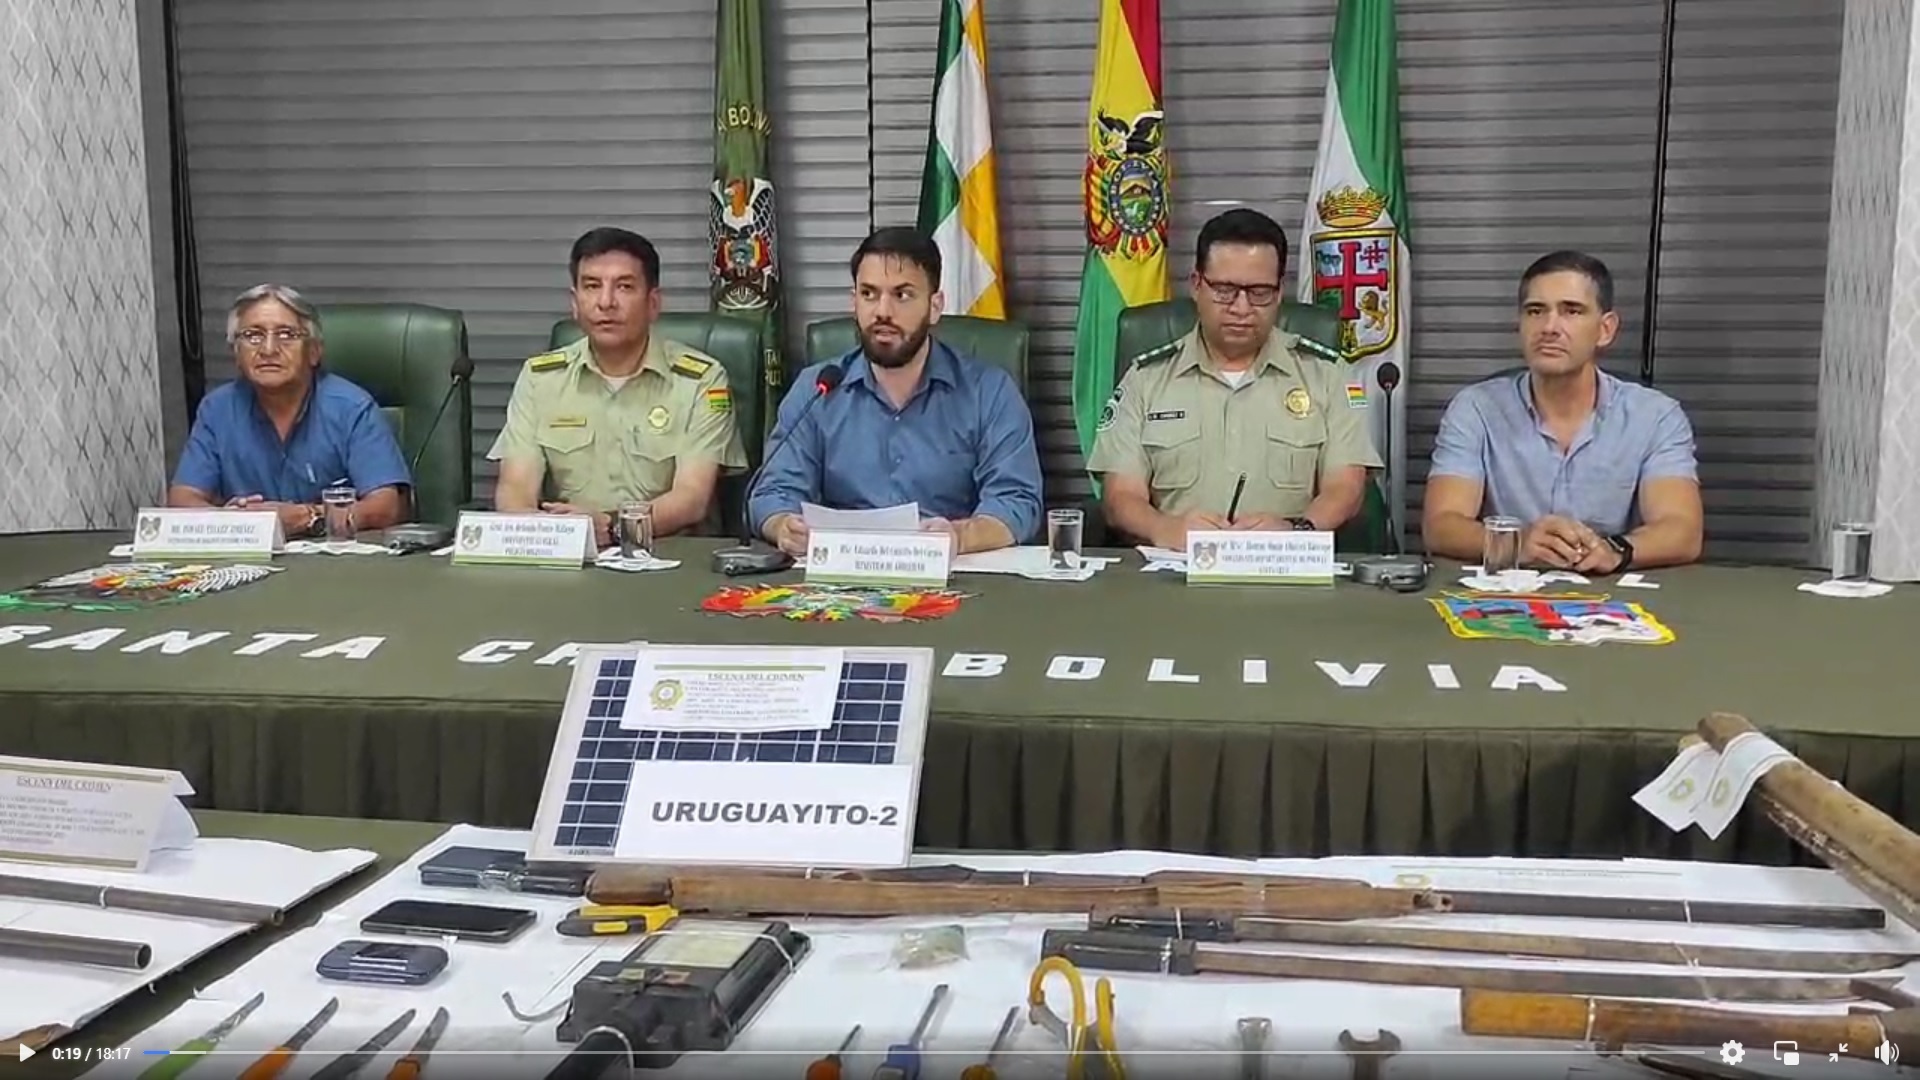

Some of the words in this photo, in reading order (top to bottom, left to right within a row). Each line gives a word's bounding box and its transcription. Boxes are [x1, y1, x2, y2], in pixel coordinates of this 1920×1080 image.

[0, 625, 386, 659] SANTA
[941, 652, 1568, 692] BOLIVIA
[651, 801, 899, 826] URUGUAYITO-2
